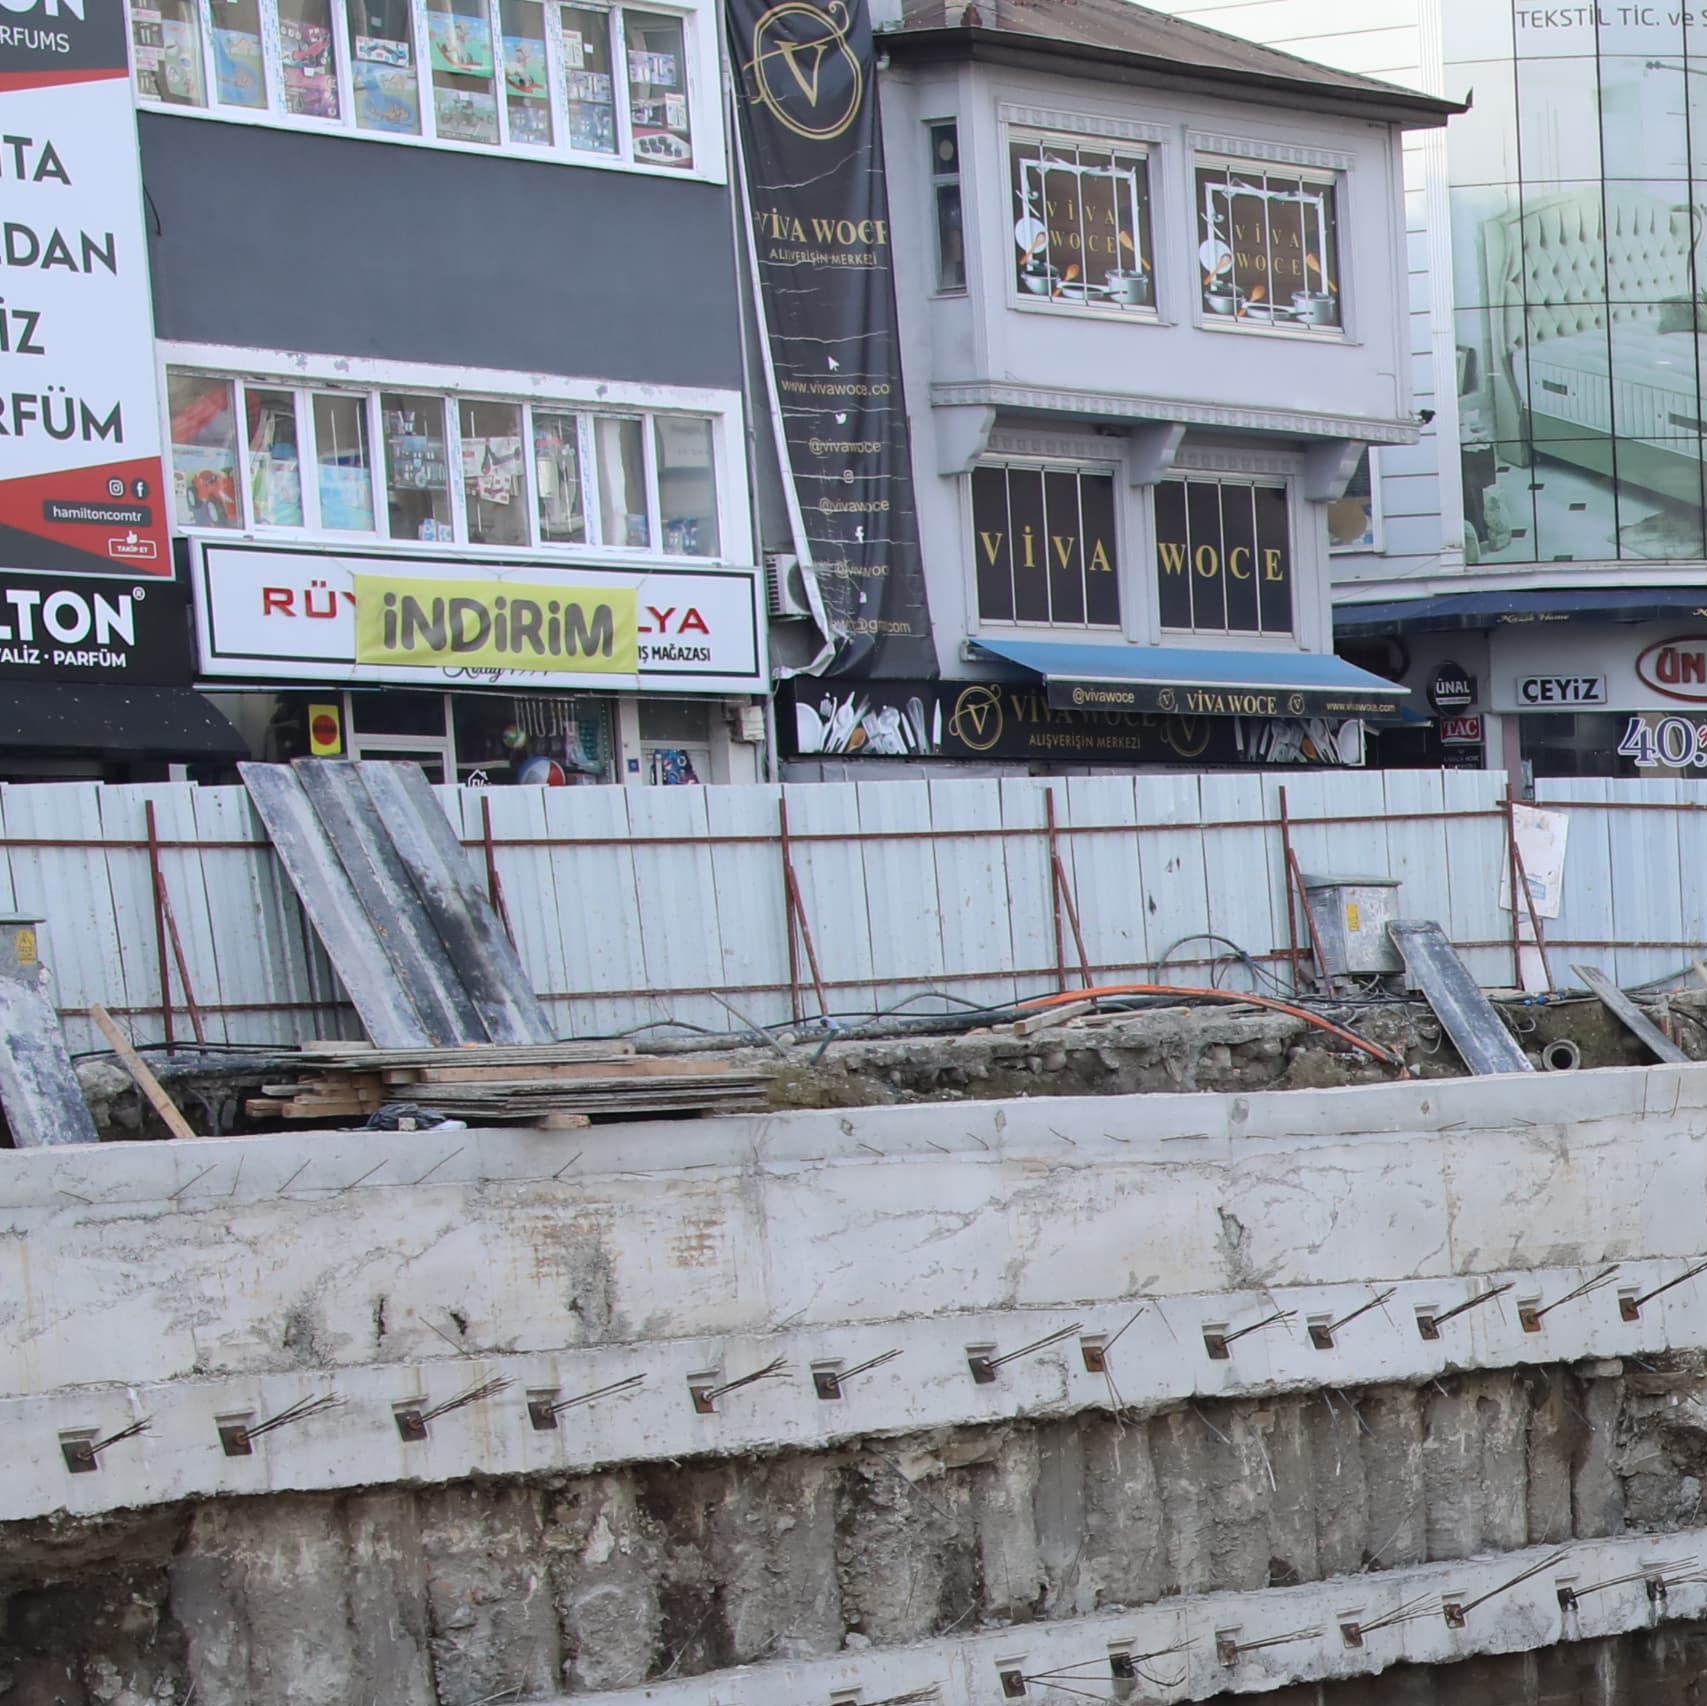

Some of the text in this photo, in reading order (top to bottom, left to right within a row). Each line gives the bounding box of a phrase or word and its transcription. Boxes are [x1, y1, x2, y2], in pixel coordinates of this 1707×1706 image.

[1669, 12, 1695, 28] ve
[0, 134, 73, 187] TA
[0, 222, 118, 277] DAN
[1050, 229, 1116, 255] WOCE
[1236, 250, 1302, 275] WOCE
[53, 505, 143, 522] hamiltoncomtr
[979, 525, 1113, 572] VİVA
[1157, 542, 1285, 582] WOCE
[54, 648, 127, 669] PARFÜM
[651, 644, 711, 662] MAĞAZASI
[1072, 686, 1135, 705] @vivawoce
[1435, 678, 1471, 695] ÜNAL
[1186, 688, 1278, 715] VİVA WOCE
